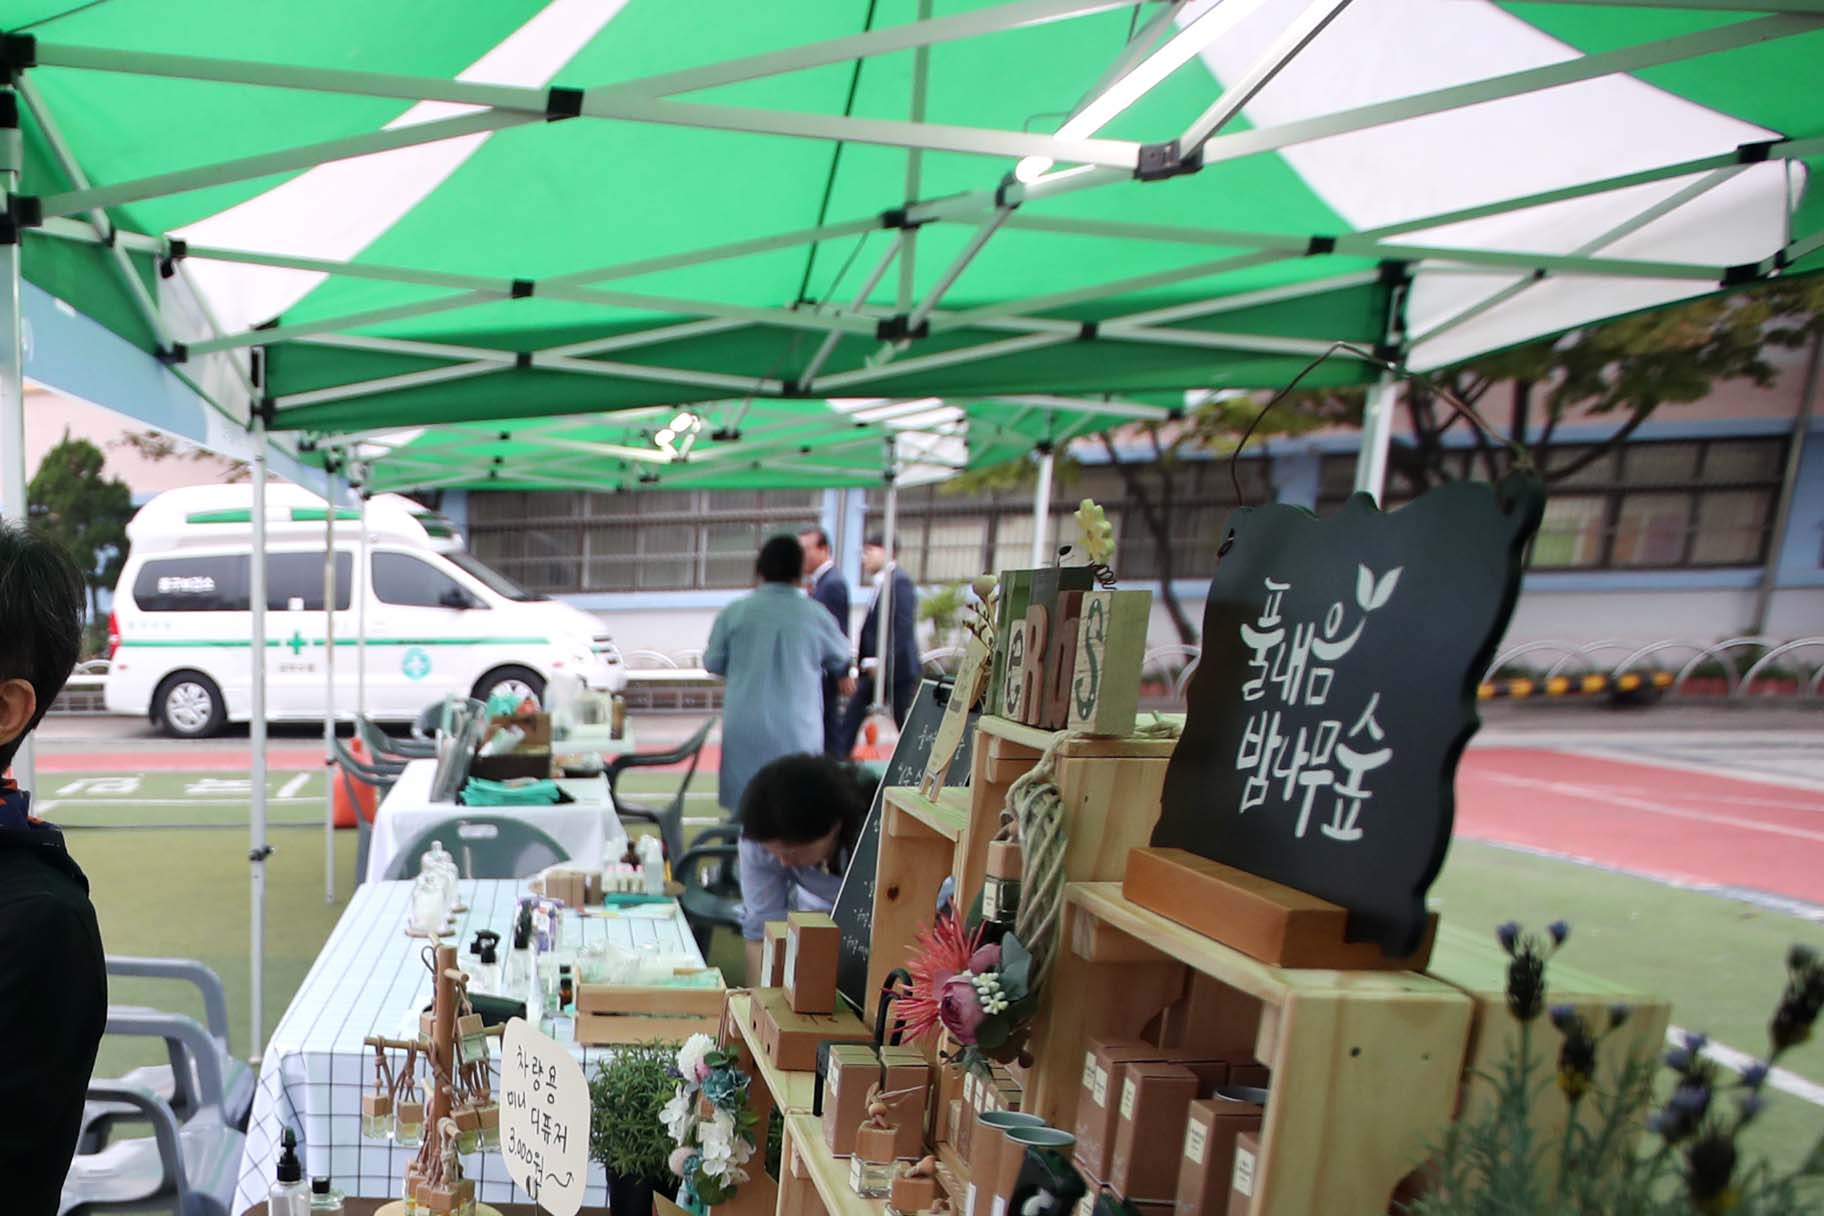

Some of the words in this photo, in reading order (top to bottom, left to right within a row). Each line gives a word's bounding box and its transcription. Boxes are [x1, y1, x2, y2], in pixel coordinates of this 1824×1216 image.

[516, 1045, 557, 1104] 차량용
[507, 1091, 526, 1110] 미니
[531, 1107, 568, 1154] 디퓨저
